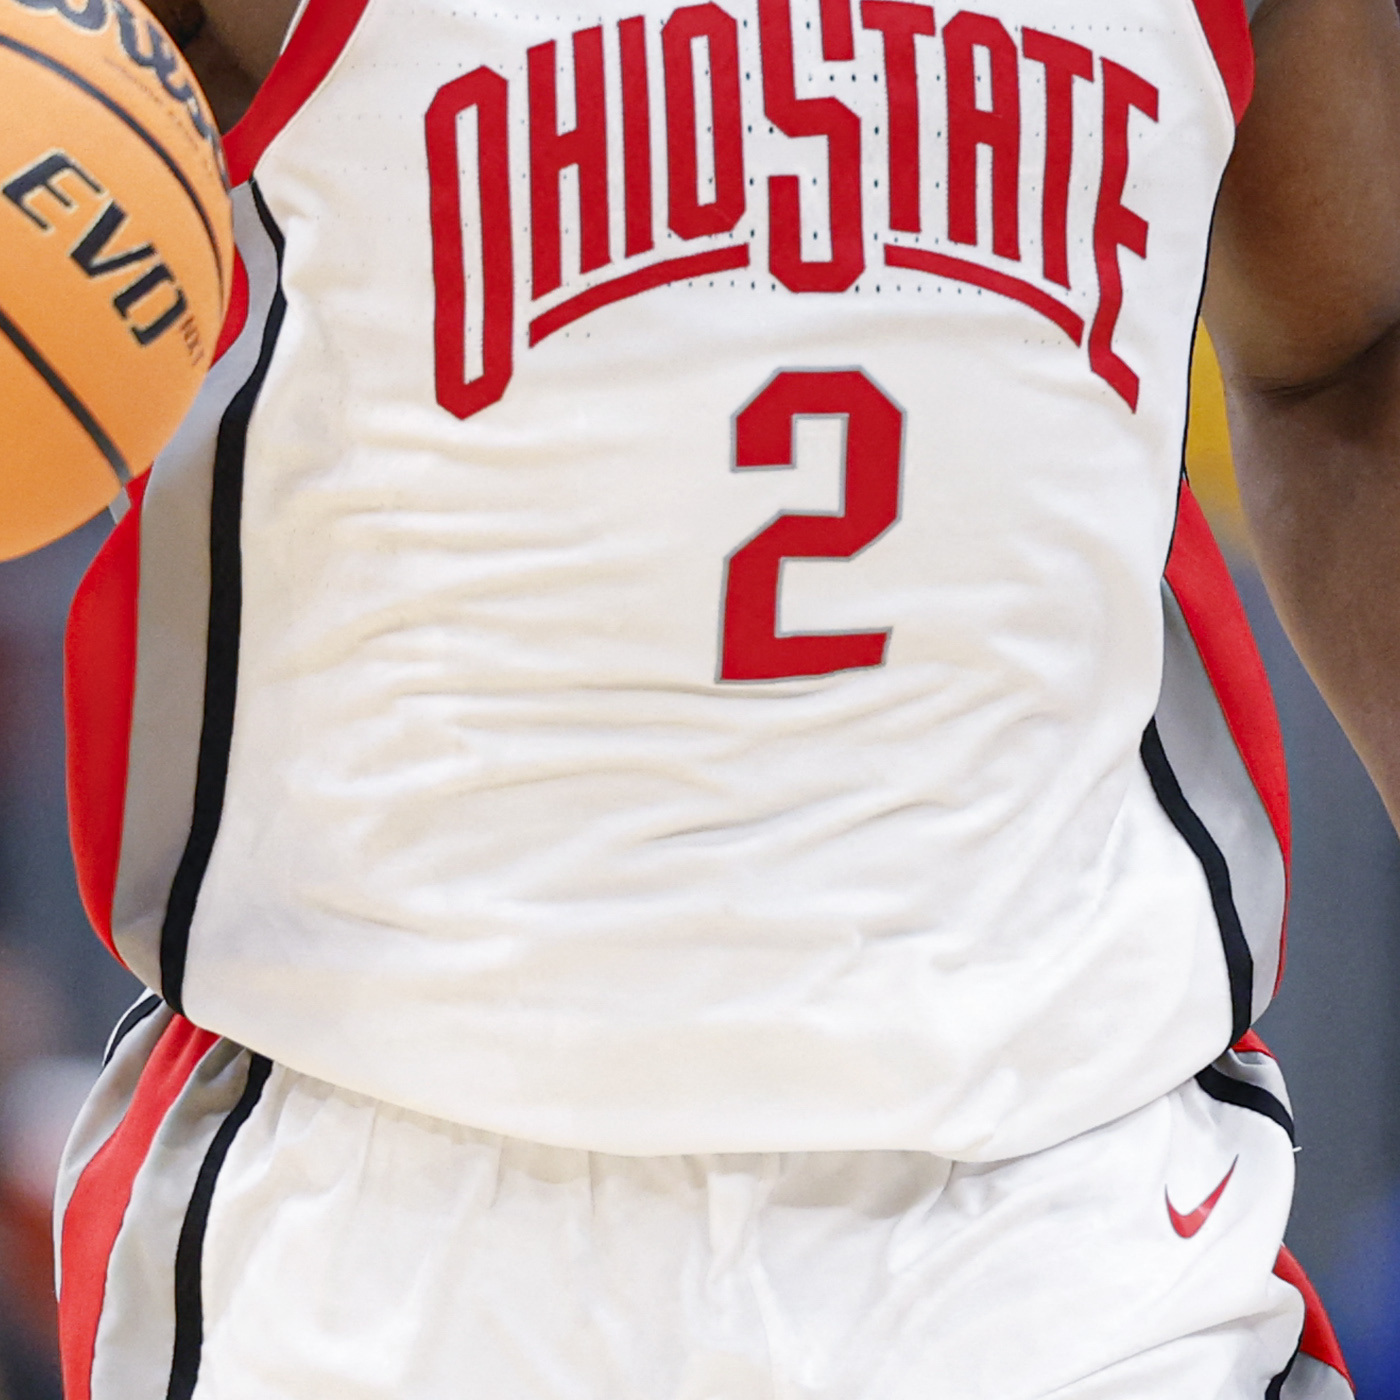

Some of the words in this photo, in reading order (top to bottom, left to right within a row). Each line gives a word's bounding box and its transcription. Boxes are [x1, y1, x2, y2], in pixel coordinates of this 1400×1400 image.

[1, 148, 188, 349] EVO
[424, 1, 747, 421] OHIO
[715, 366, 907, 685] 2
